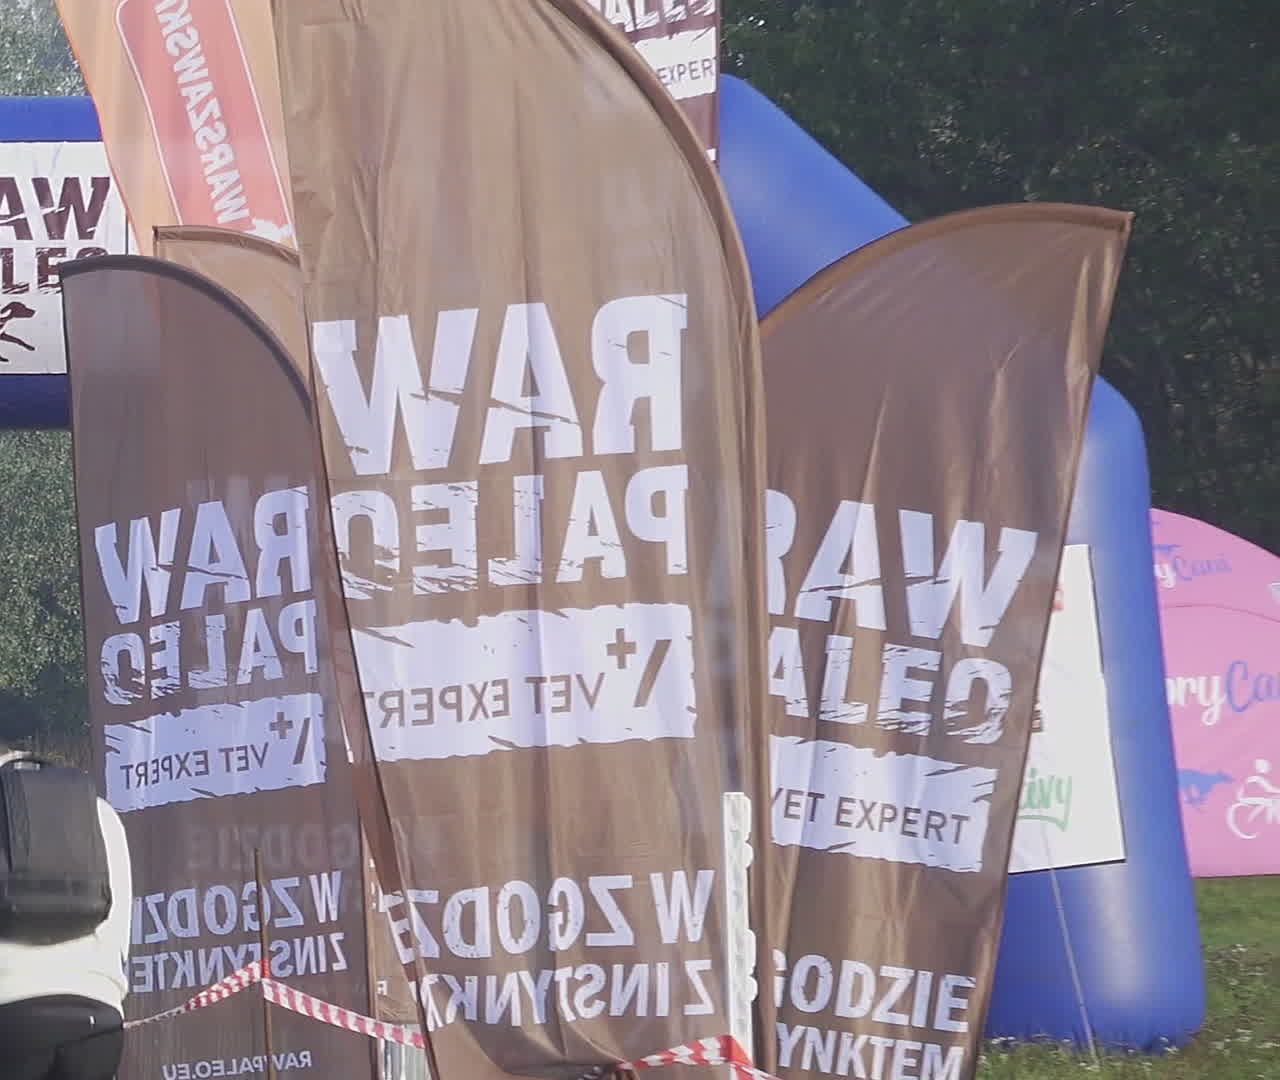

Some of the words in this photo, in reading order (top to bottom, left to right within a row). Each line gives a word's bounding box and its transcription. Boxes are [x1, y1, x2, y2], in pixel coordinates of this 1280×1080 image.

[656, 56, 718, 86] EXPER
[768, 627, 1012, 744] ALEO
[836, 797, 970, 845] EXPERT
[773, 949, 977, 1033] ODZIE
